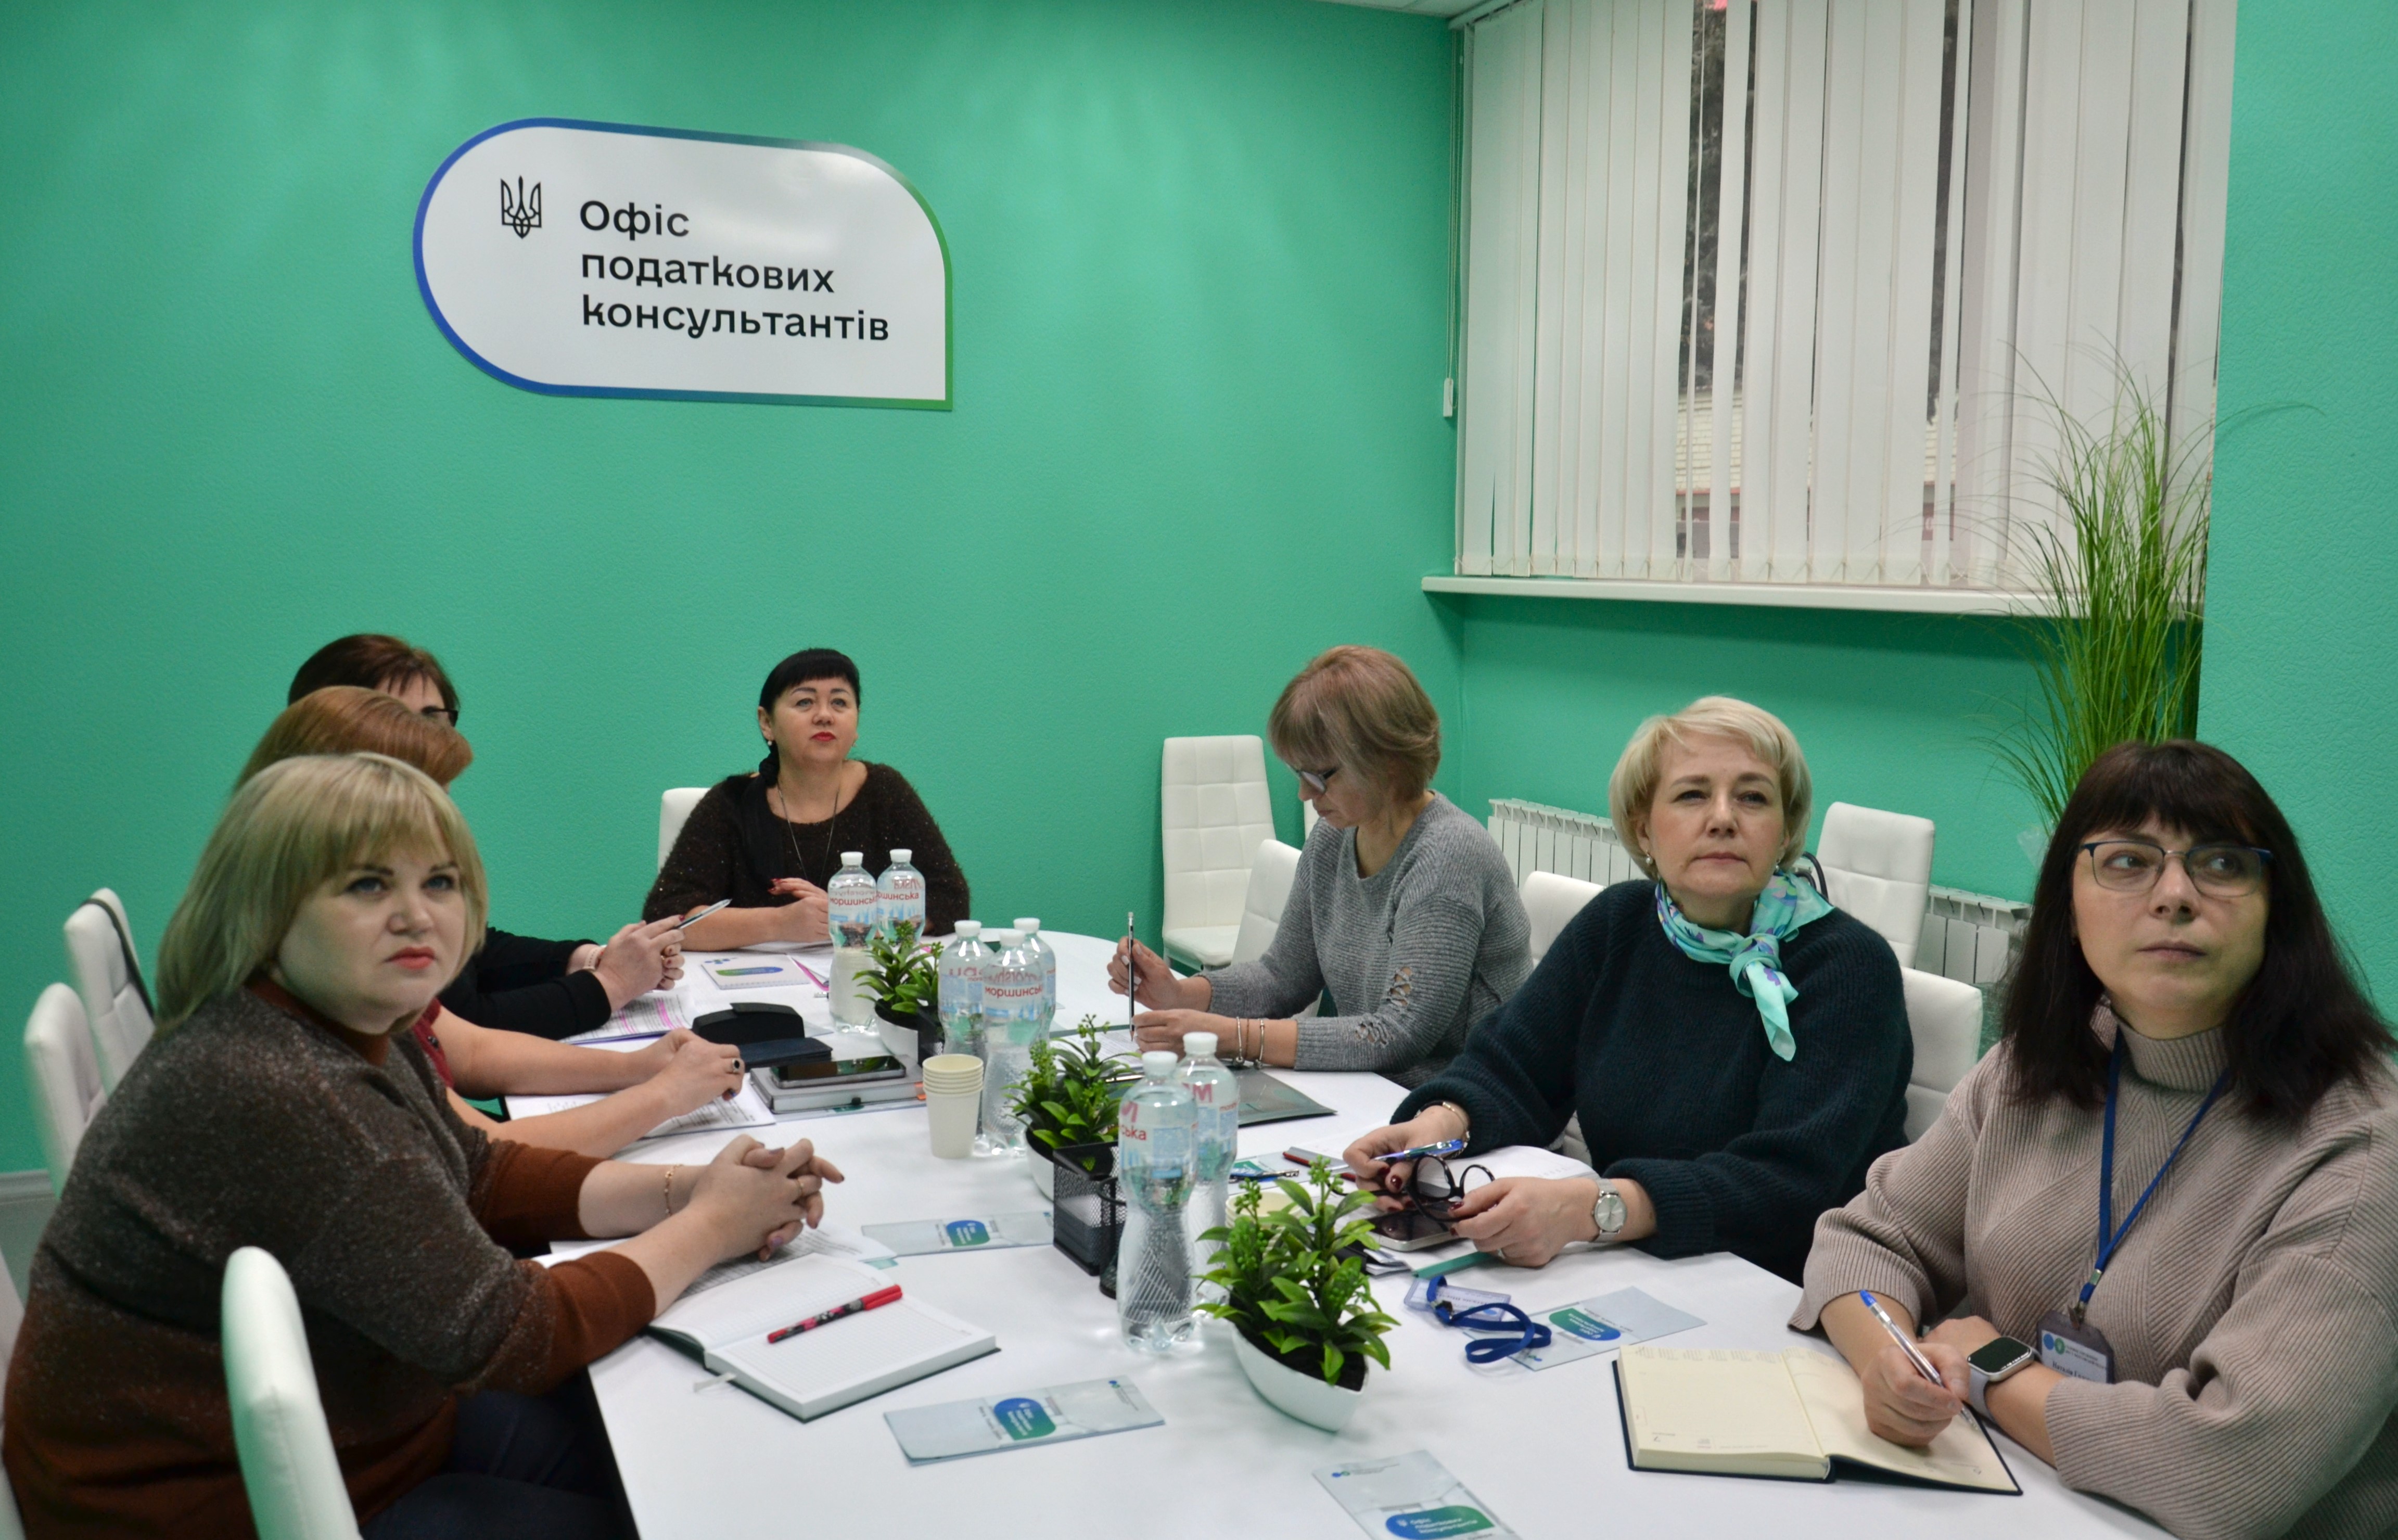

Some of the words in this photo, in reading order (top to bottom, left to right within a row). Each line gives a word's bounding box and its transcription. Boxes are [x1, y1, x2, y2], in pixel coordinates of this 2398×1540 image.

[579, 200, 690, 241] Офіс
[582, 253, 835, 294] податкових
[582, 294, 889, 341] консультантів
[830, 895, 876, 906] моршинськ
[876, 890, 919, 900] ршинська
[985, 984, 1043, 999] моршинськ
